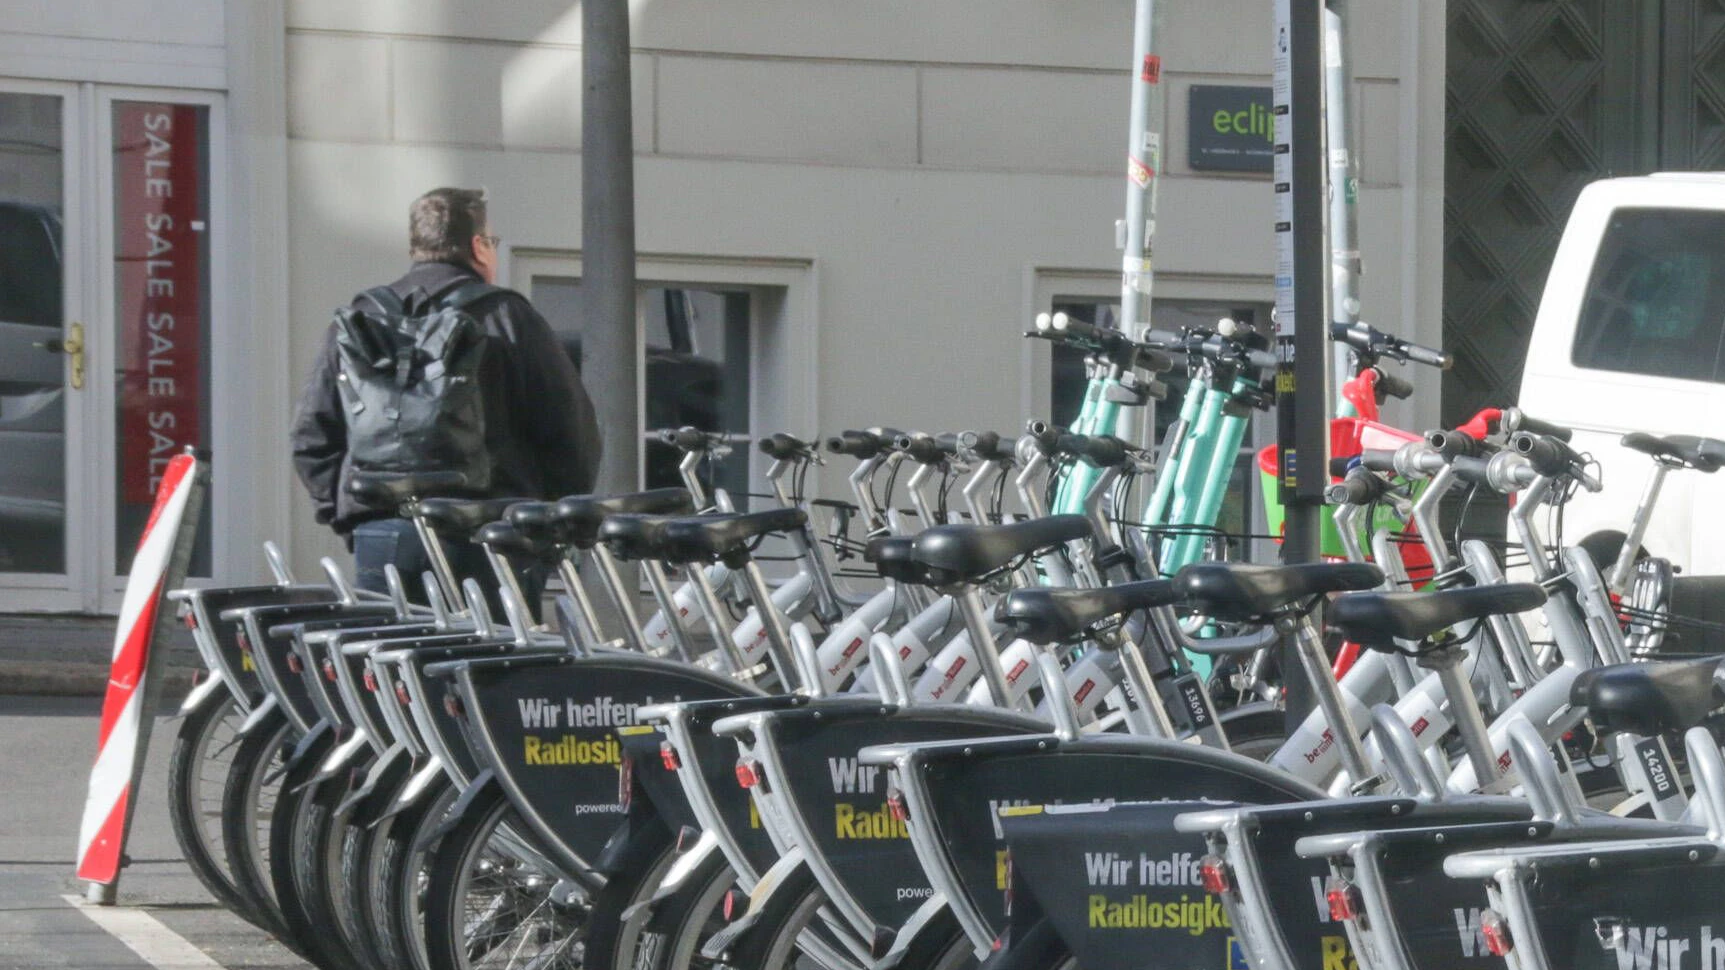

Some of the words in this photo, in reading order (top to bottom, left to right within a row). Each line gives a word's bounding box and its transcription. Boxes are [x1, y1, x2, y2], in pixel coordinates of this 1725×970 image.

[143, 112, 173, 198] SALE
[145, 212, 174, 298] SALE
[147, 311, 175, 397] SALE
[518, 698, 562, 729] Wir
[566, 695, 641, 728] helfen
[1185, 687, 1206, 722] 13696
[1642, 748, 1670, 793] 14200
[1085, 852, 1132, 886] Wir
